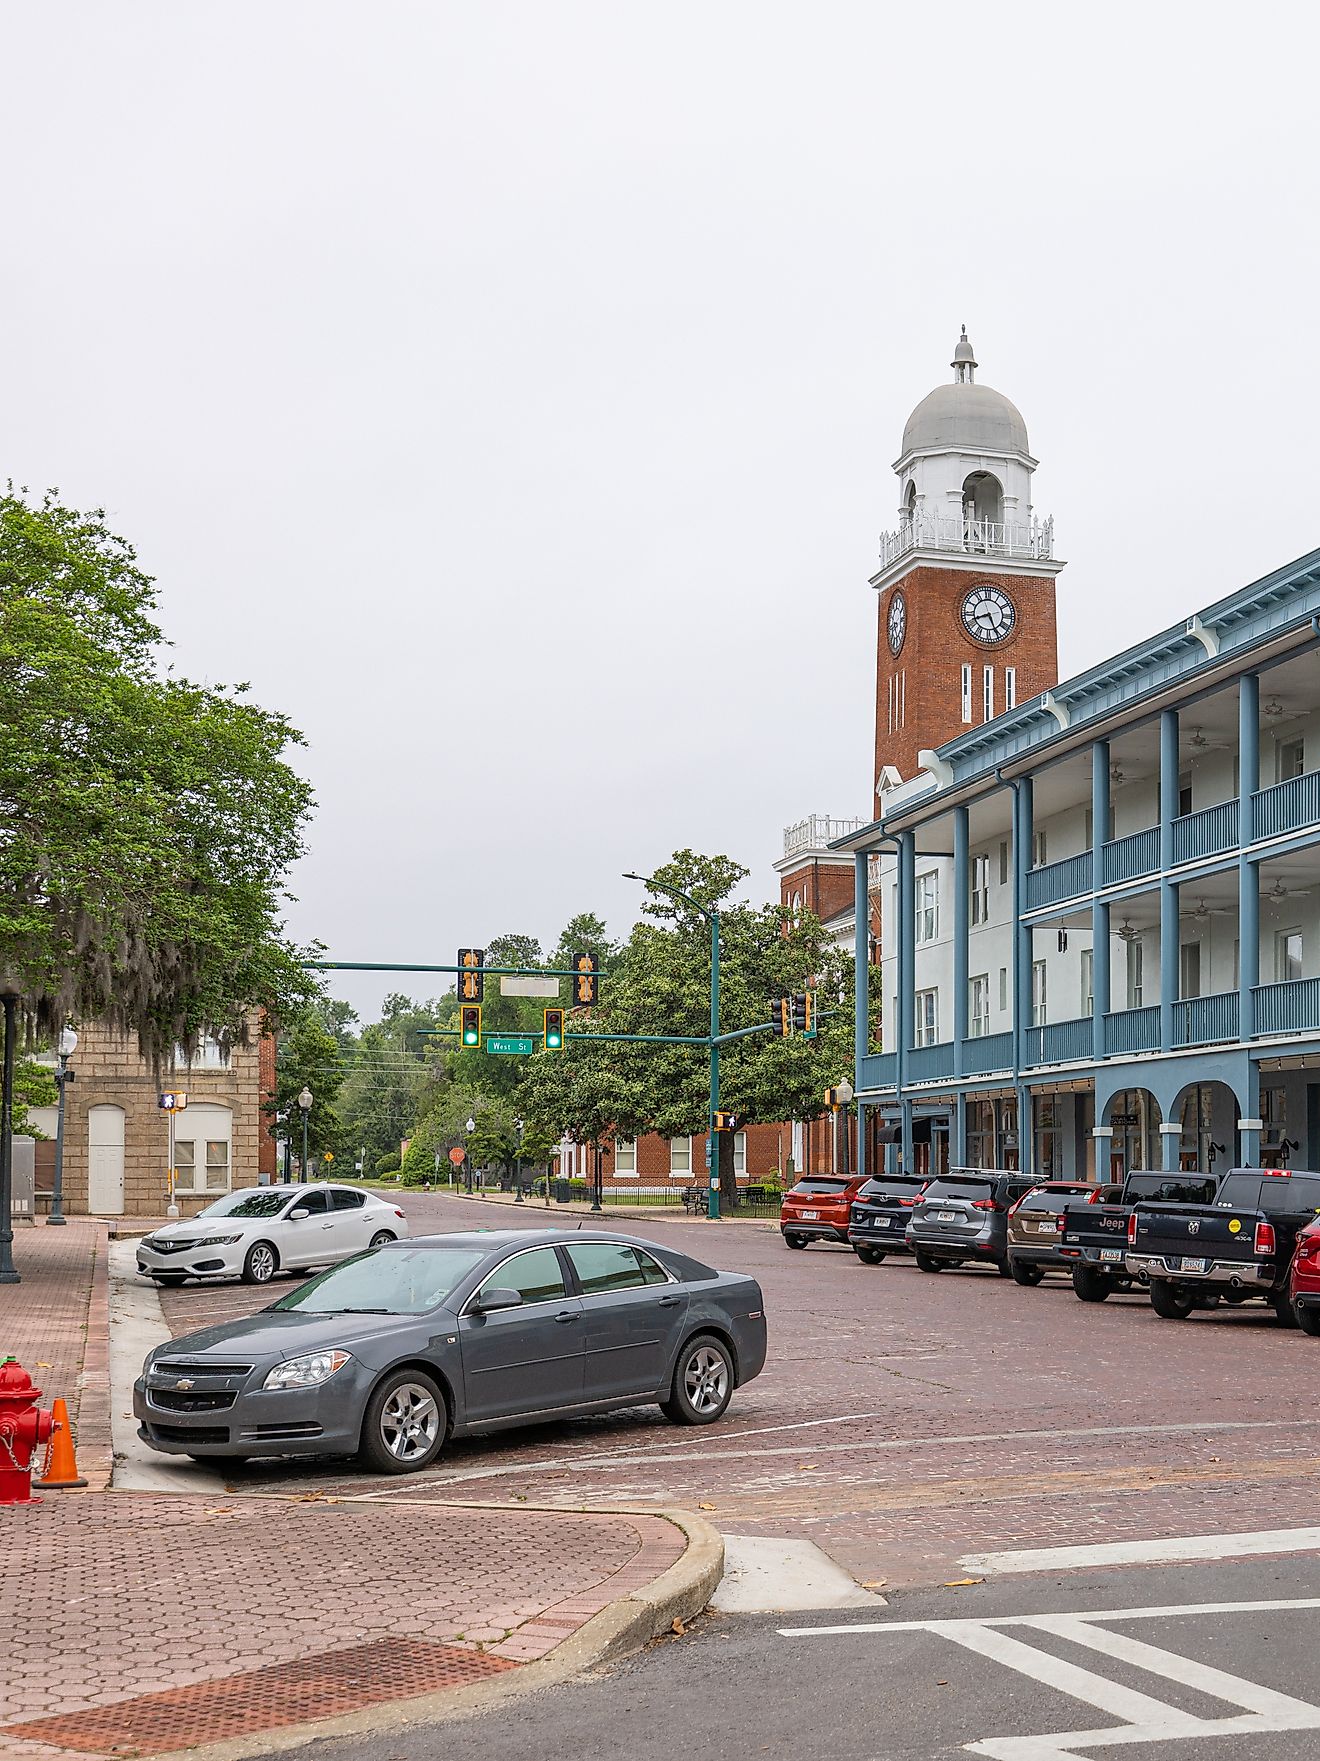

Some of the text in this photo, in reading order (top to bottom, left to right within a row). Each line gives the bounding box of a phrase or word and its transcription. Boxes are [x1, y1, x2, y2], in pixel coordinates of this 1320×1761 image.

[493, 1042, 527, 1051] West St
[1099, 1216, 1125, 1231] Jeep
